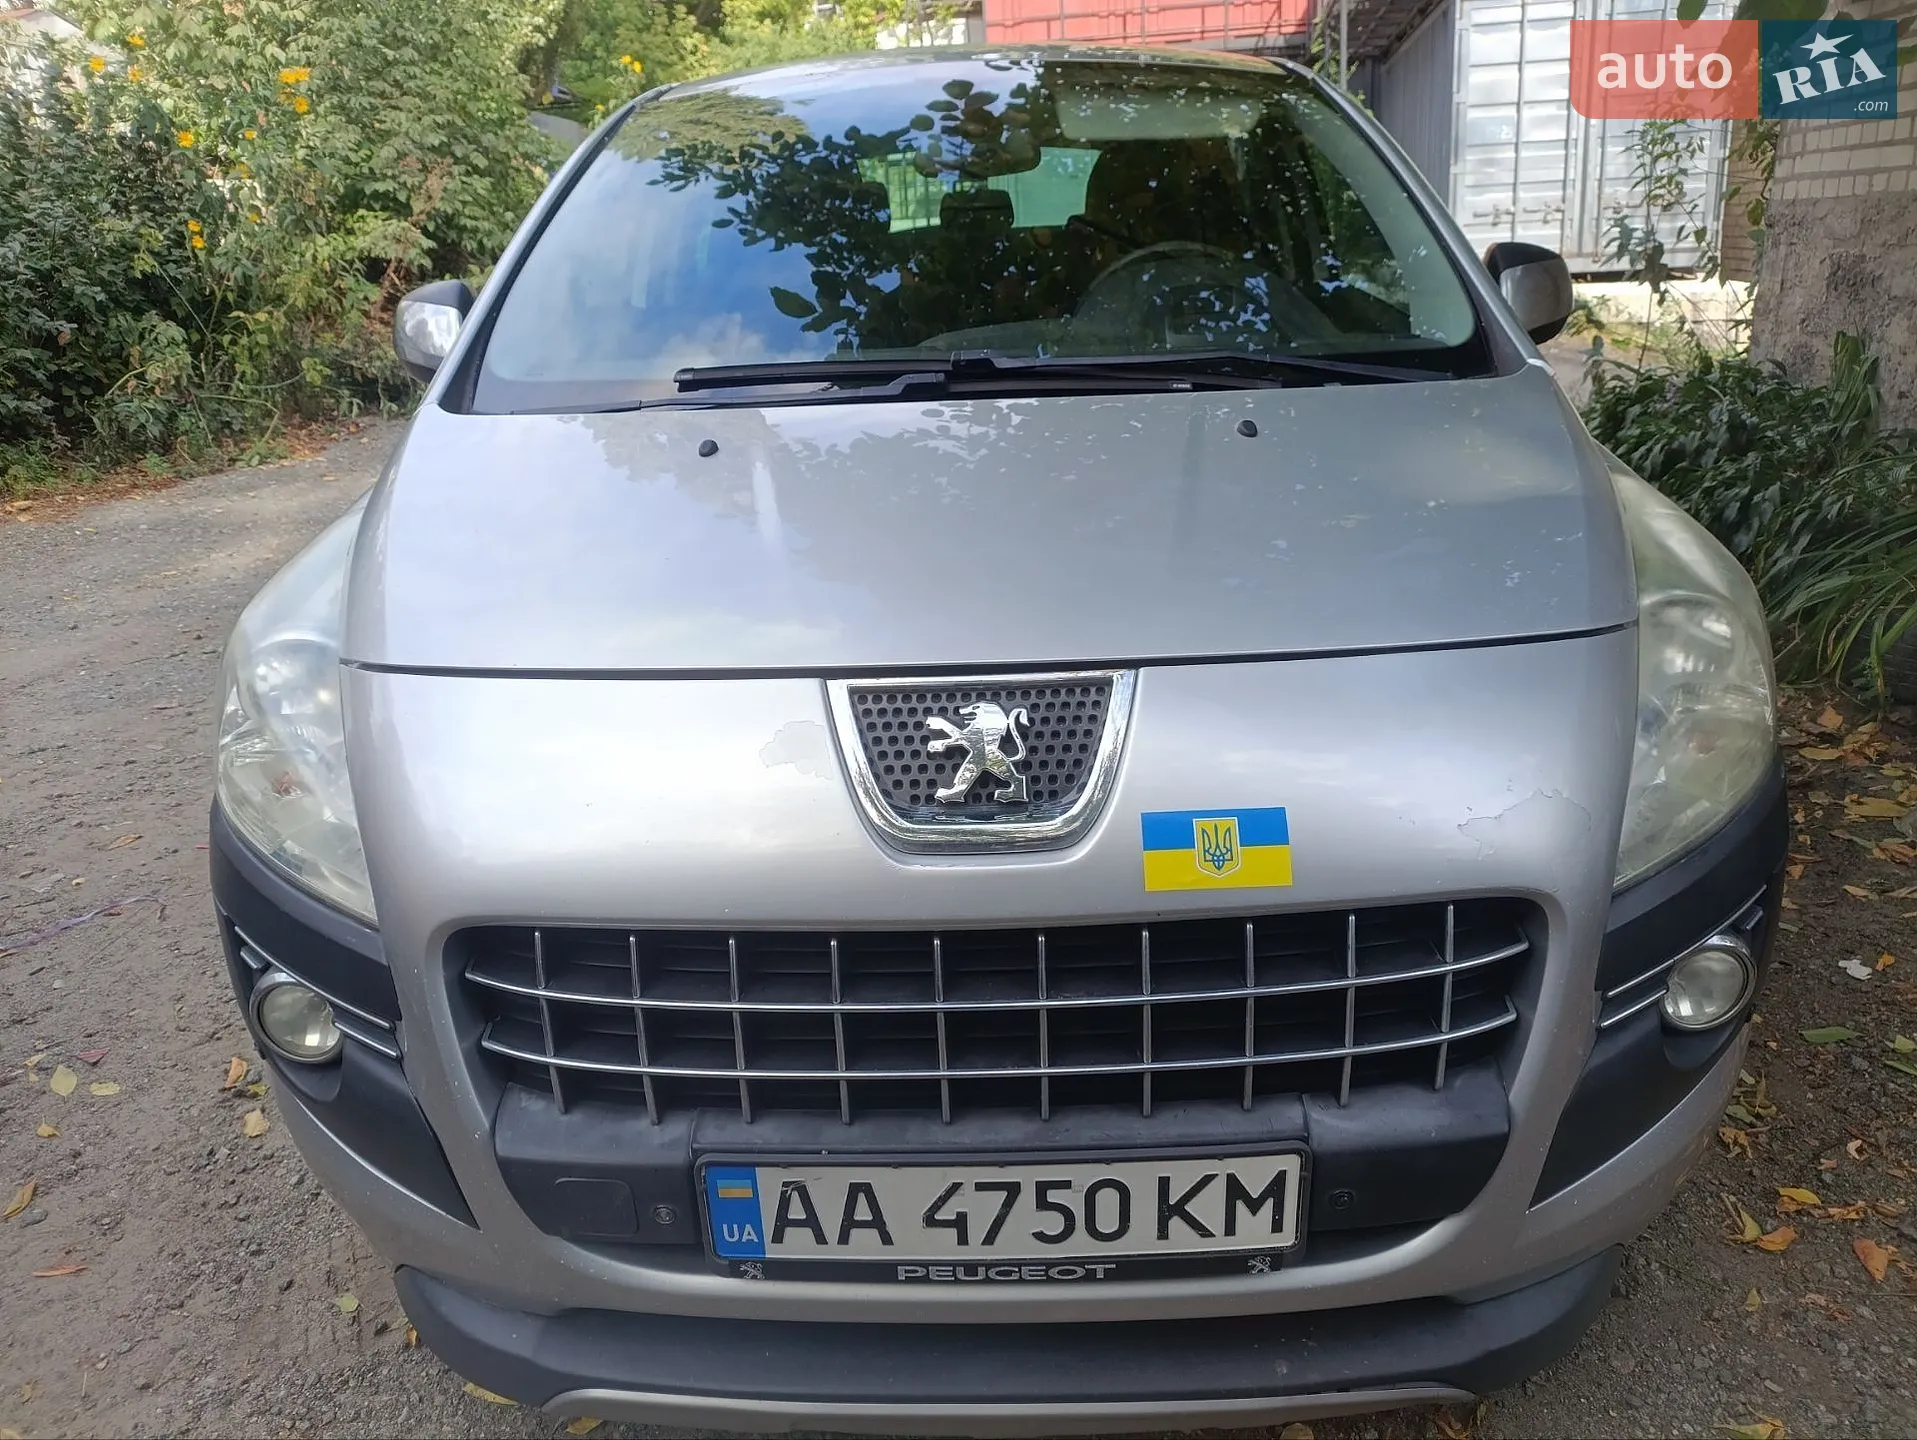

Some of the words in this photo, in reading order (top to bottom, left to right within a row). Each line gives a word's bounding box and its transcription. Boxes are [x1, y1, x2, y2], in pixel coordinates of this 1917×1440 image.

[771, 1179, 895, 1246] AA
[922, 1177, 1131, 1246] 4750
[1156, 1168, 1288, 1241] KM
[722, 1223, 759, 1243] UA
[897, 1263, 1117, 1281] PEUGEOT
